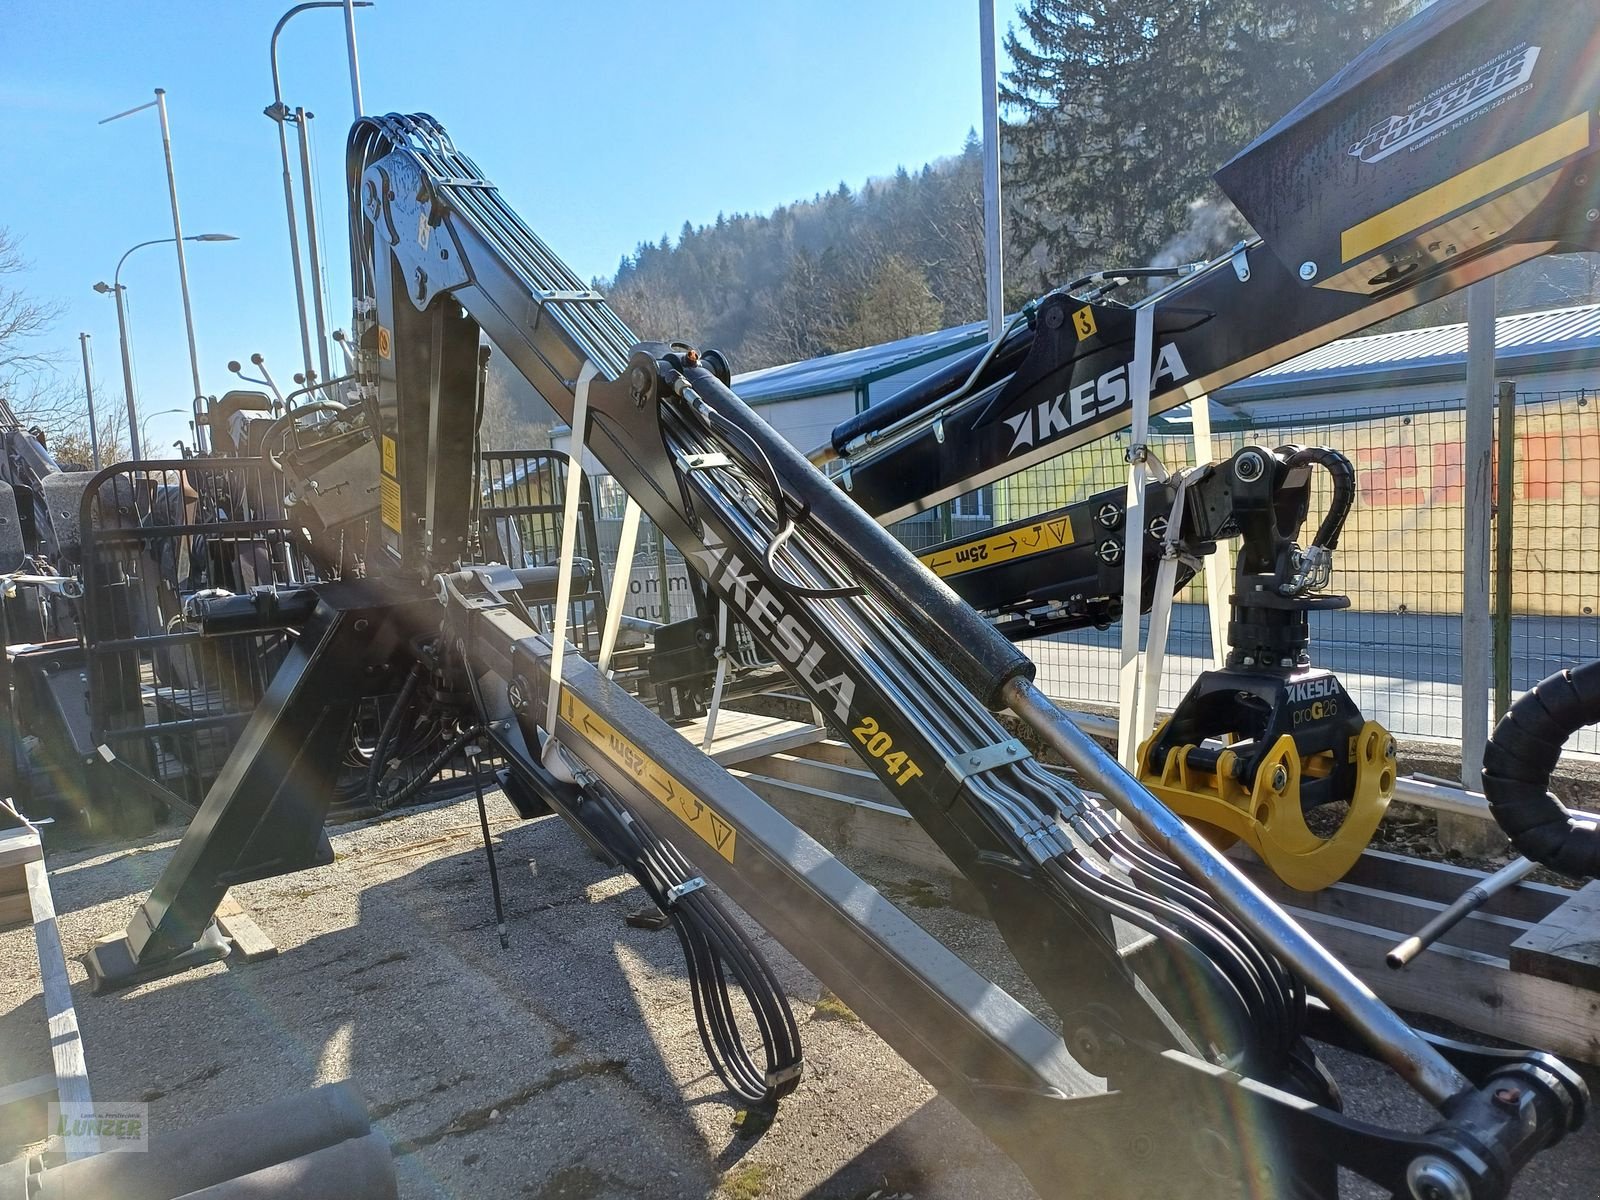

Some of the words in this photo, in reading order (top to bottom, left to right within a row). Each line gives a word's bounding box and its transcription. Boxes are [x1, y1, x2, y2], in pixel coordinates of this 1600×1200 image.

[1422, 68, 1477, 102] LANDMASCHINE
[1477, 48, 1512, 72] natürlich
[1360, 61, 1525, 161] LUNZER
[1037, 342, 1190, 440] KESA
[956, 544, 989, 563] 25m
[718, 554, 856, 726] KESLA
[1293, 698, 1338, 728] proG26
[1297, 678, 1340, 702] KESLA
[609, 734, 644, 776] 25m
[852, 716, 923, 786] 204T
